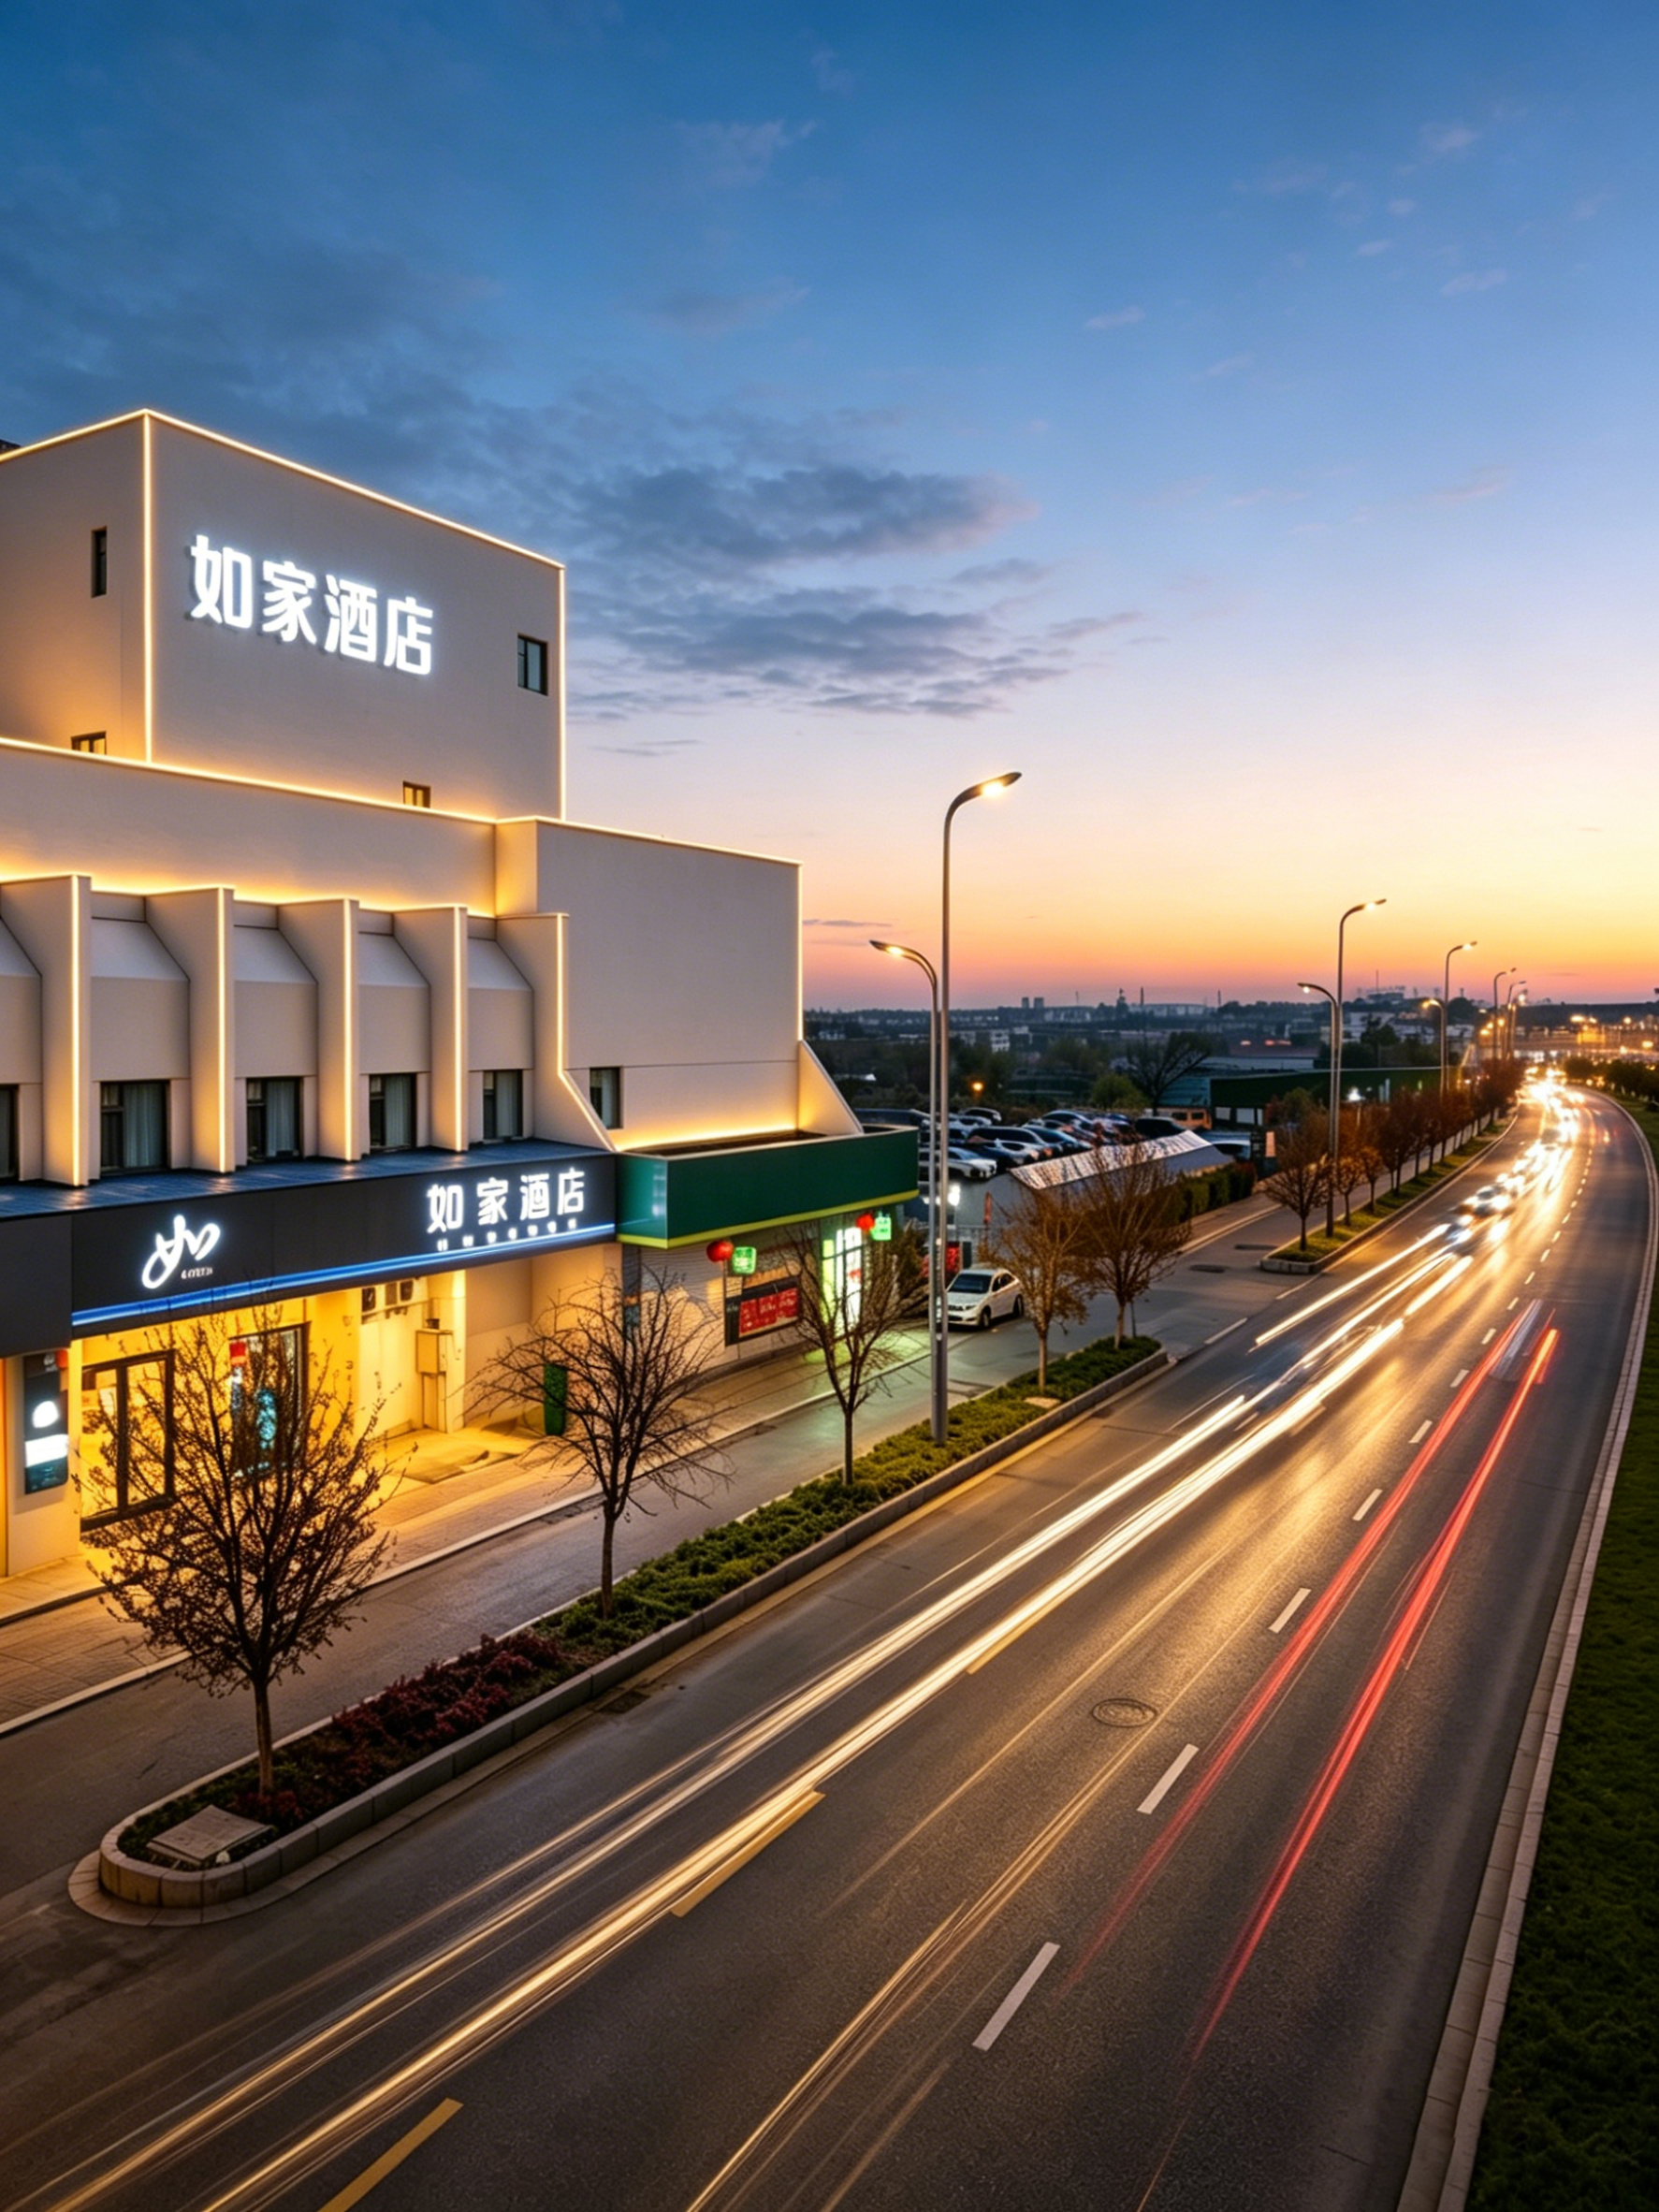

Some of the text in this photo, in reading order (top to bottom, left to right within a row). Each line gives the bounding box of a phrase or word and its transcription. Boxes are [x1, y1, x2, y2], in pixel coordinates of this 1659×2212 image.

[191, 534, 433, 676] 如家酒店
[427, 1168, 585, 1233] 如家酒店
